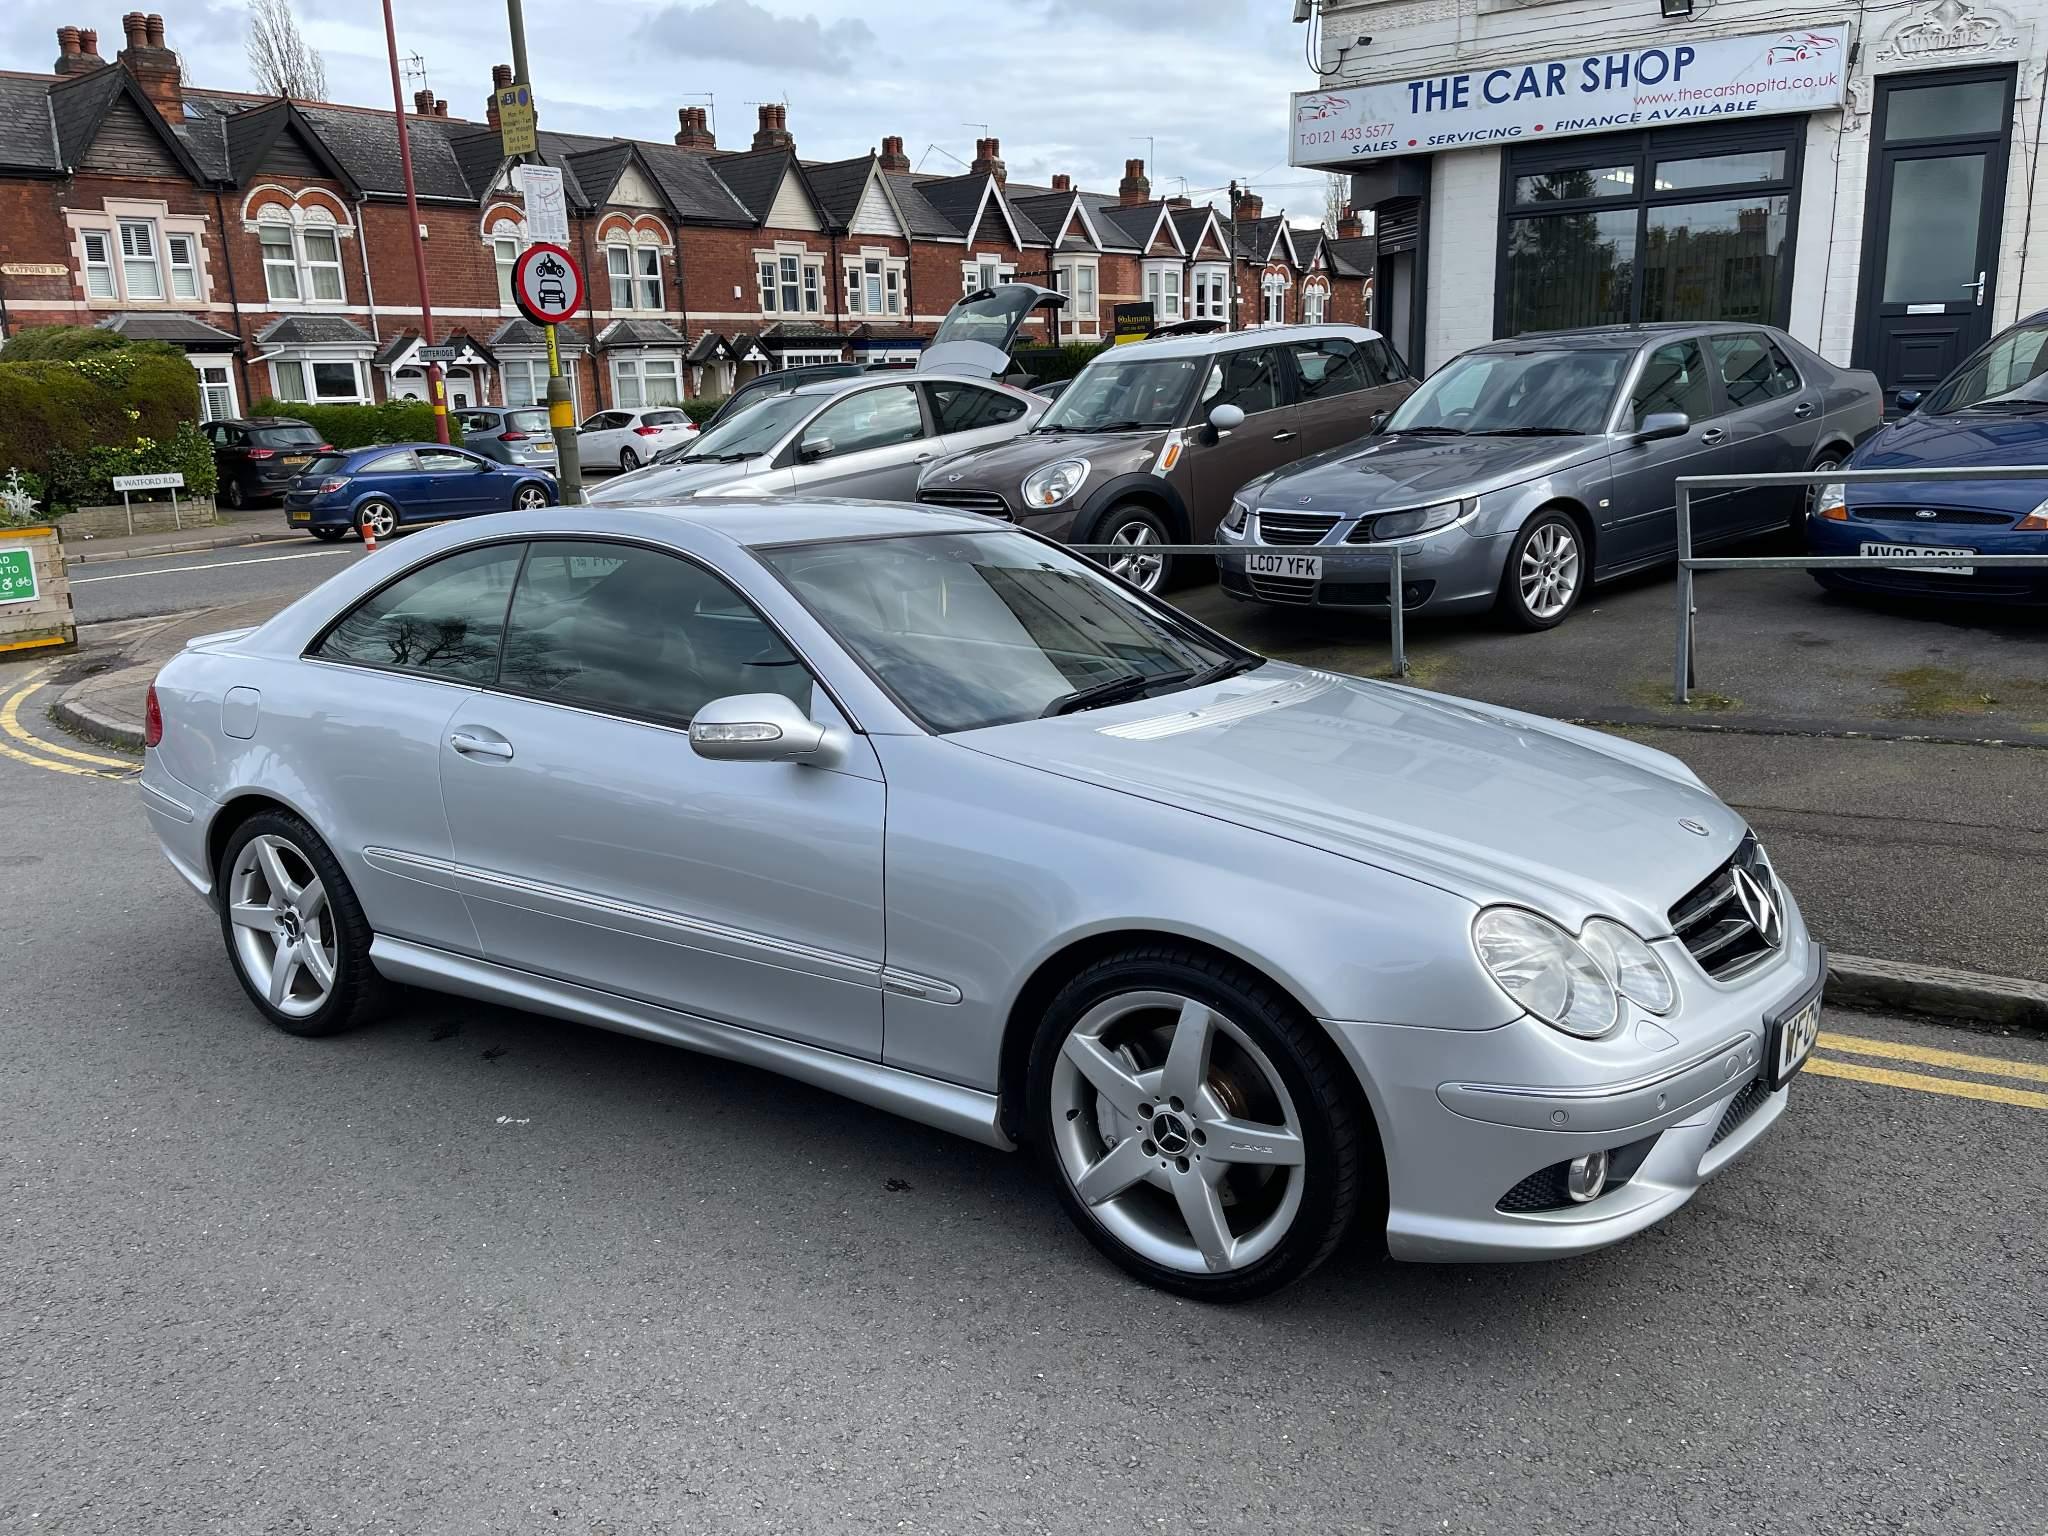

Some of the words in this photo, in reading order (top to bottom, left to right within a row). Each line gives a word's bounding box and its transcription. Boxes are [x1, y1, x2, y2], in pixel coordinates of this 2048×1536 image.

[1408, 74, 1470, 114] THE
[1483, 63, 1566, 104] CAR
[1580, 46, 1695, 93] SHOP
[1633, 72, 1838, 106] www.thecarshopltd.co.uk
[1300, 130, 1335, 146] T:0121
[1340, 128, 1362, 141] 433
[1365, 123, 1395, 138] 5577
[1351, 140, 1398, 154] SALES
[1427, 126, 1522, 146] SERVICING
[1555, 112, 1642, 132] FINANCE
[1647, 100, 1758, 121] AVAILABLE
[8, 266, 47, 274] WATFORD
[123, 478, 162, 487] WATFORD
[8, 566, 19, 574] TO
[1250, 554, 1283, 573] LC07
[1287, 557, 1316, 576] YFK
